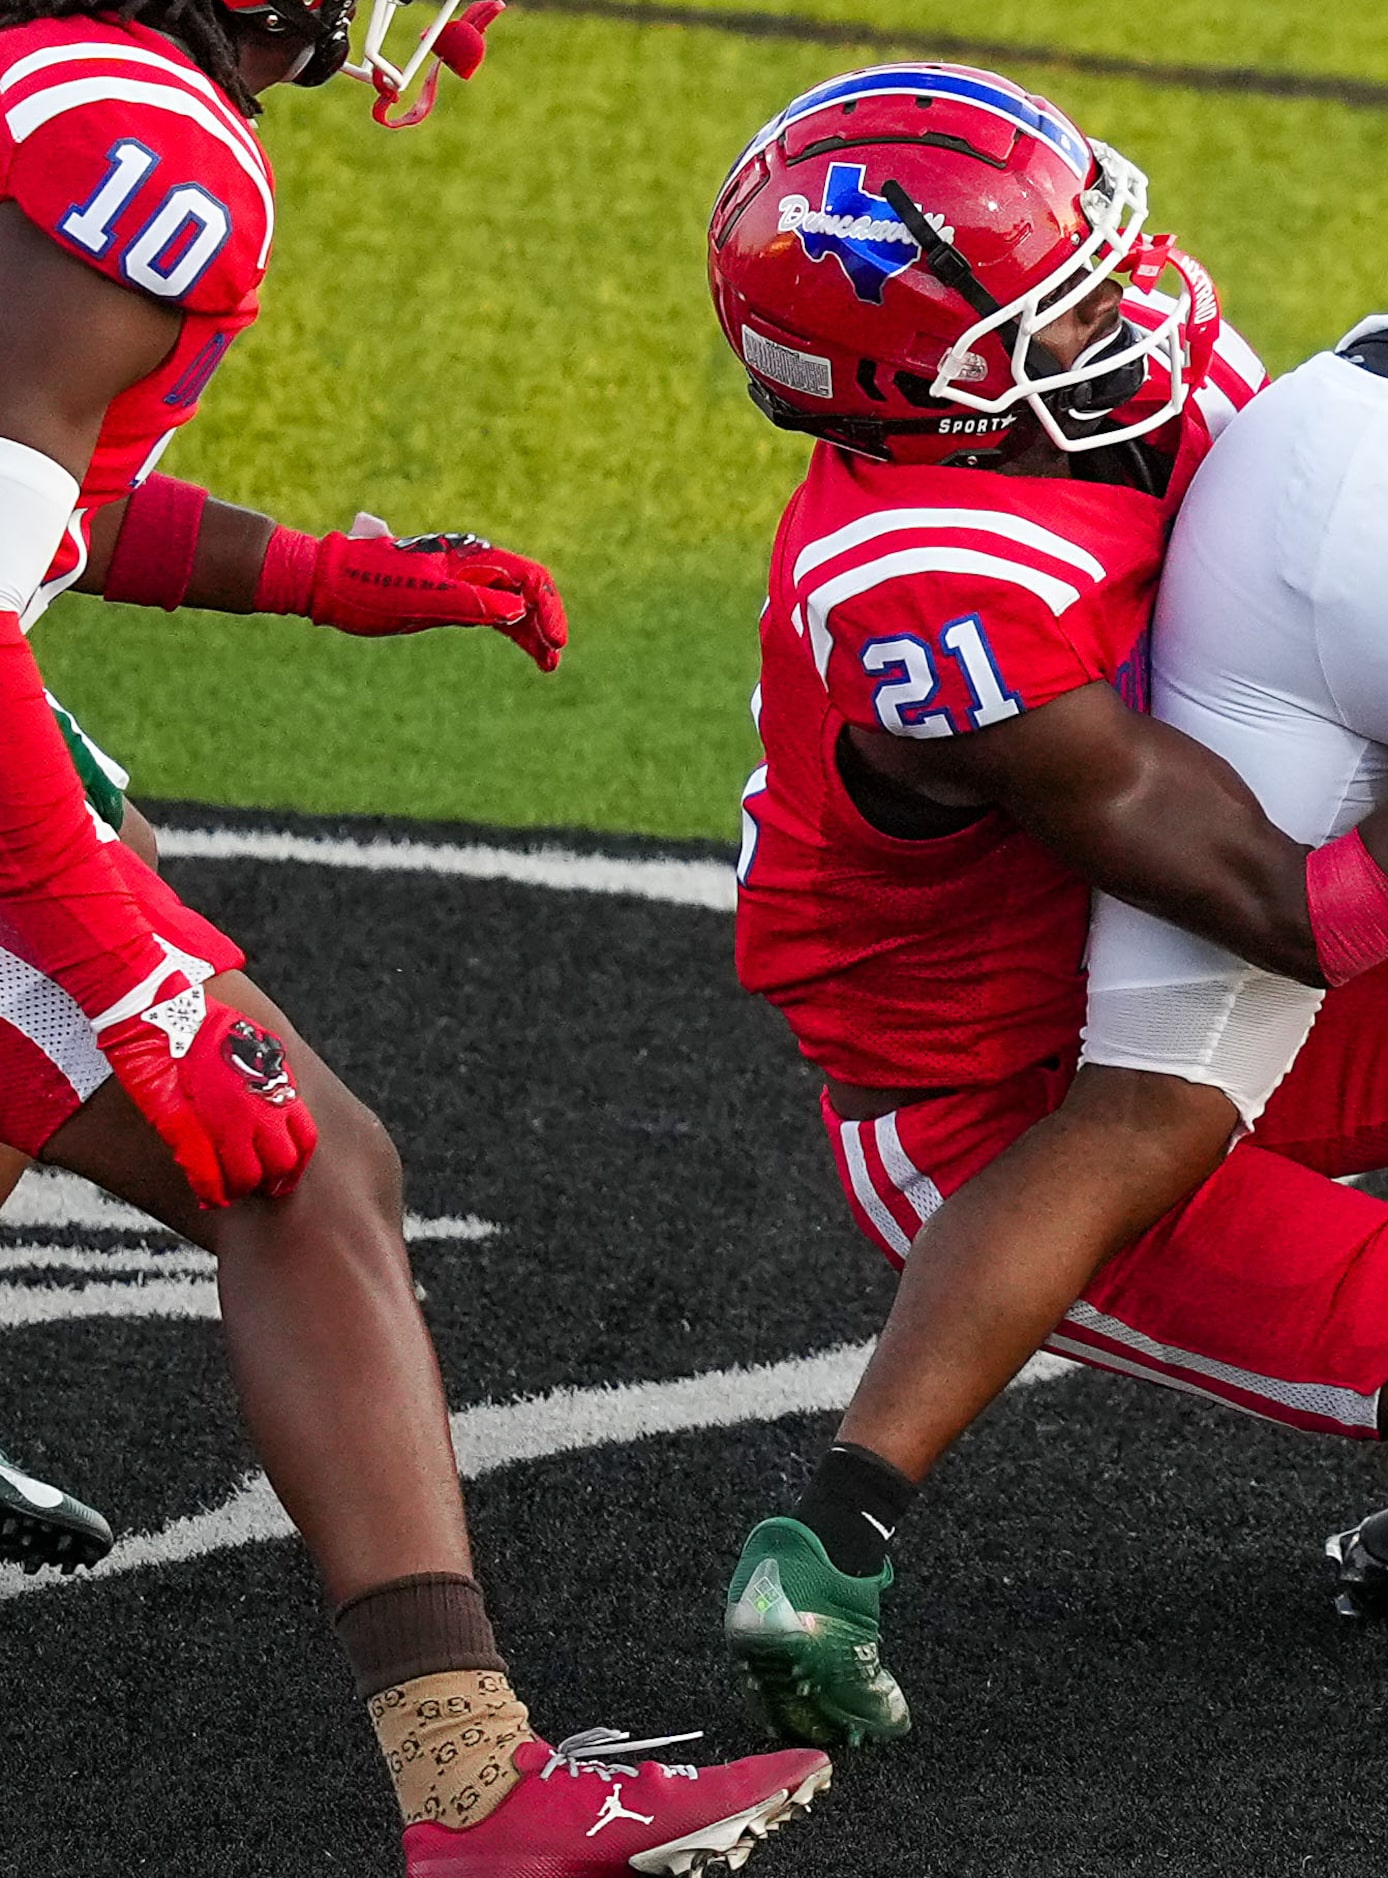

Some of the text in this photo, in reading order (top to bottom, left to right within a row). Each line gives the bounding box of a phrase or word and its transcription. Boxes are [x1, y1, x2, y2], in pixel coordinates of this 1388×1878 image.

[56, 137, 232, 301] 10
[938, 416, 1000, 434] SPORT
[858, 611, 1027, 740] 21
